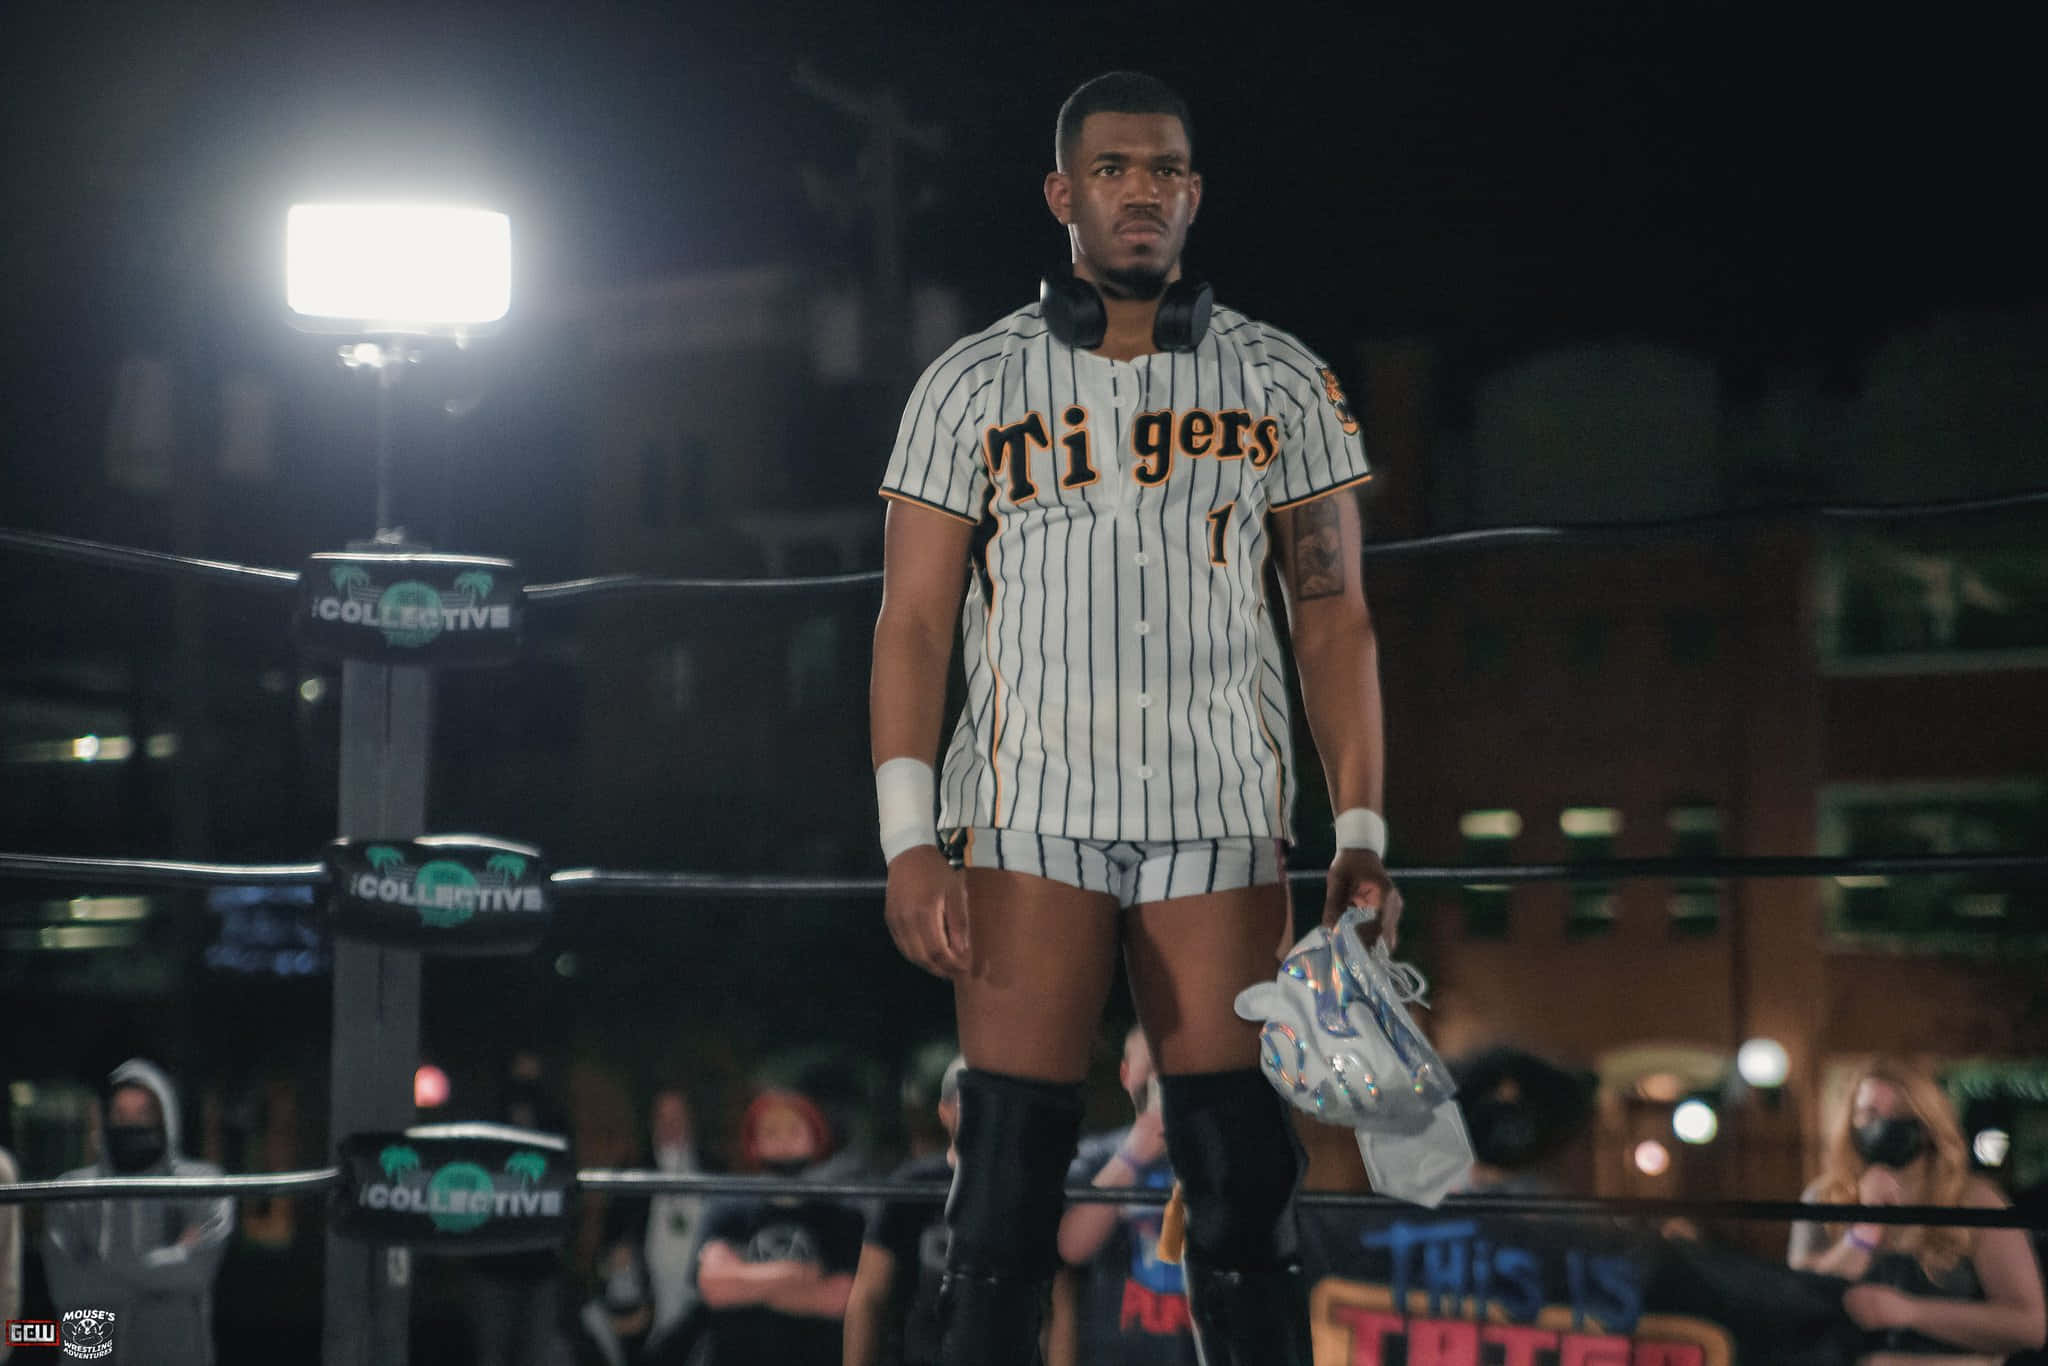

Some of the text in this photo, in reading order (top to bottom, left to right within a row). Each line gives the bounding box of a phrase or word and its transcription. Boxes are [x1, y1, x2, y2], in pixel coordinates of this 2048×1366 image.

[1207, 502, 1237, 567] 1
[318, 598, 511, 631] COLLECTIVE
[357, 875, 543, 912] COLLECTIVE
[367, 1184, 562, 1217] COLLECTIVE
